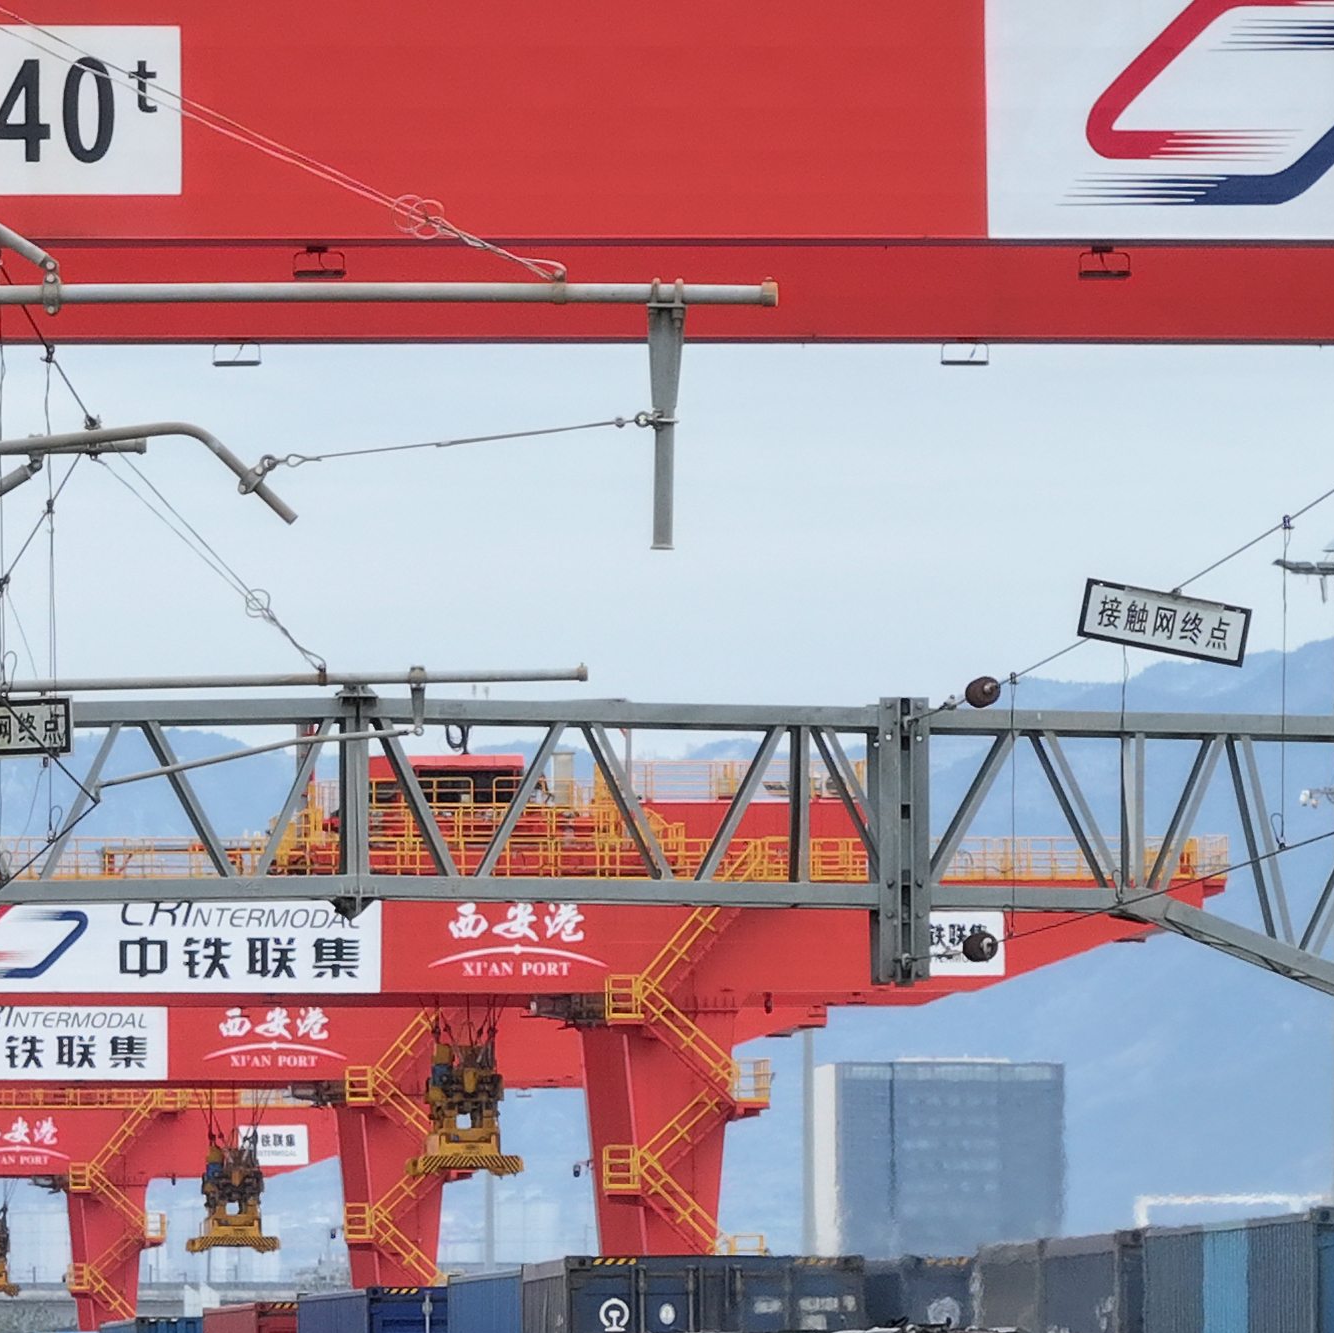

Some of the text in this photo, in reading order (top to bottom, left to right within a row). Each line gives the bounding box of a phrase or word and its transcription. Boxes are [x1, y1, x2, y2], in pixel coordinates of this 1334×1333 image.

[1096, 594, 1231, 651] 接触网终点
[447, 902, 585, 943] 西安港
[118, 936, 361, 980] 中铁联集
[462, 961, 572, 977] XI'AN PORT
[218, 1006, 330, 1041] 西安港
[230, 1054, 318, 1068] XI'AN PORT
[20, 1154, 49, 1166] PORT
